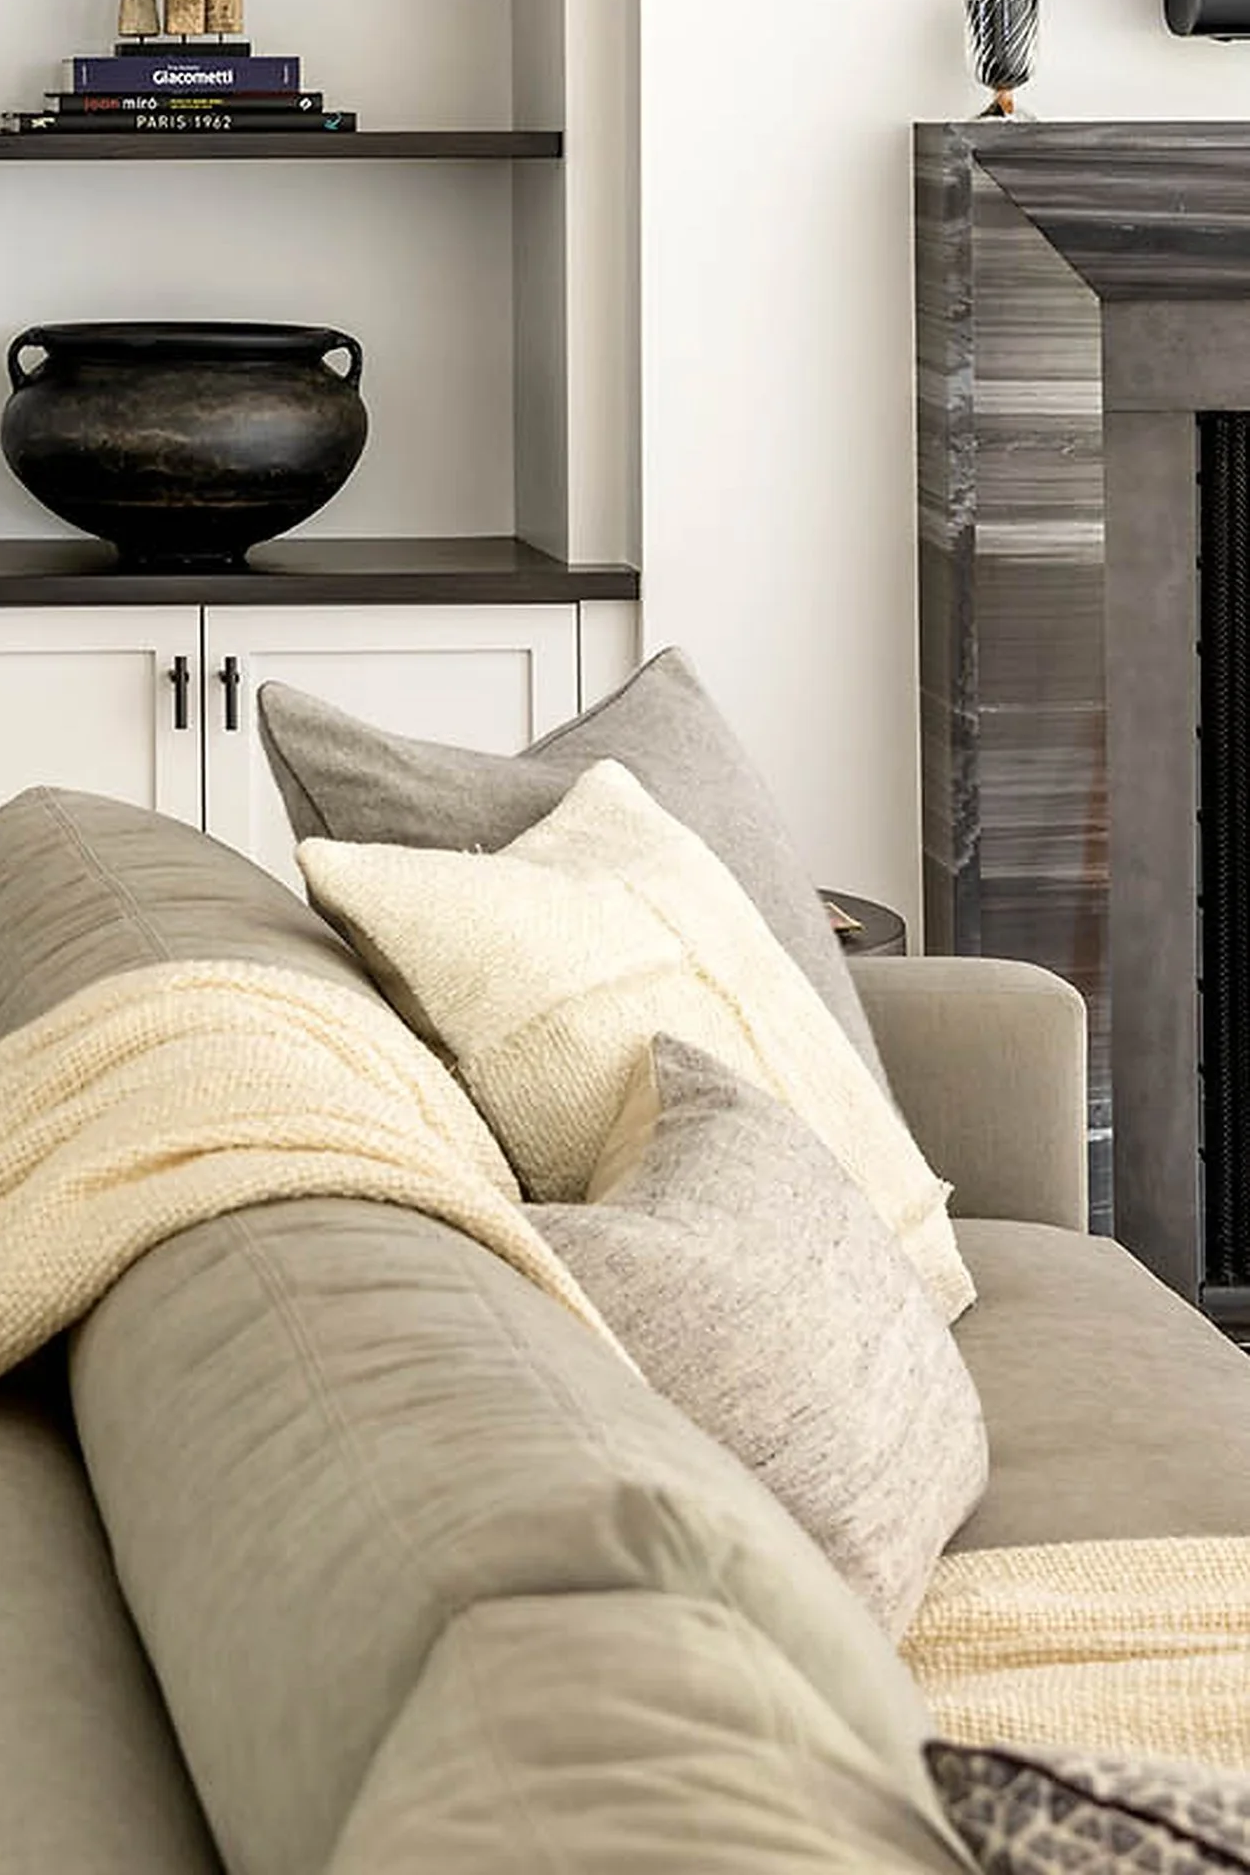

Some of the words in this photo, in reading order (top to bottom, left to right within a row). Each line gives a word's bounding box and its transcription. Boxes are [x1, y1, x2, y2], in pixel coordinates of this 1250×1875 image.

[153, 69, 234, 85] Giacometti
[122, 96, 158, 110] miró
[136, 114, 187, 129] PARIS
[194, 114, 232, 129] 1962
